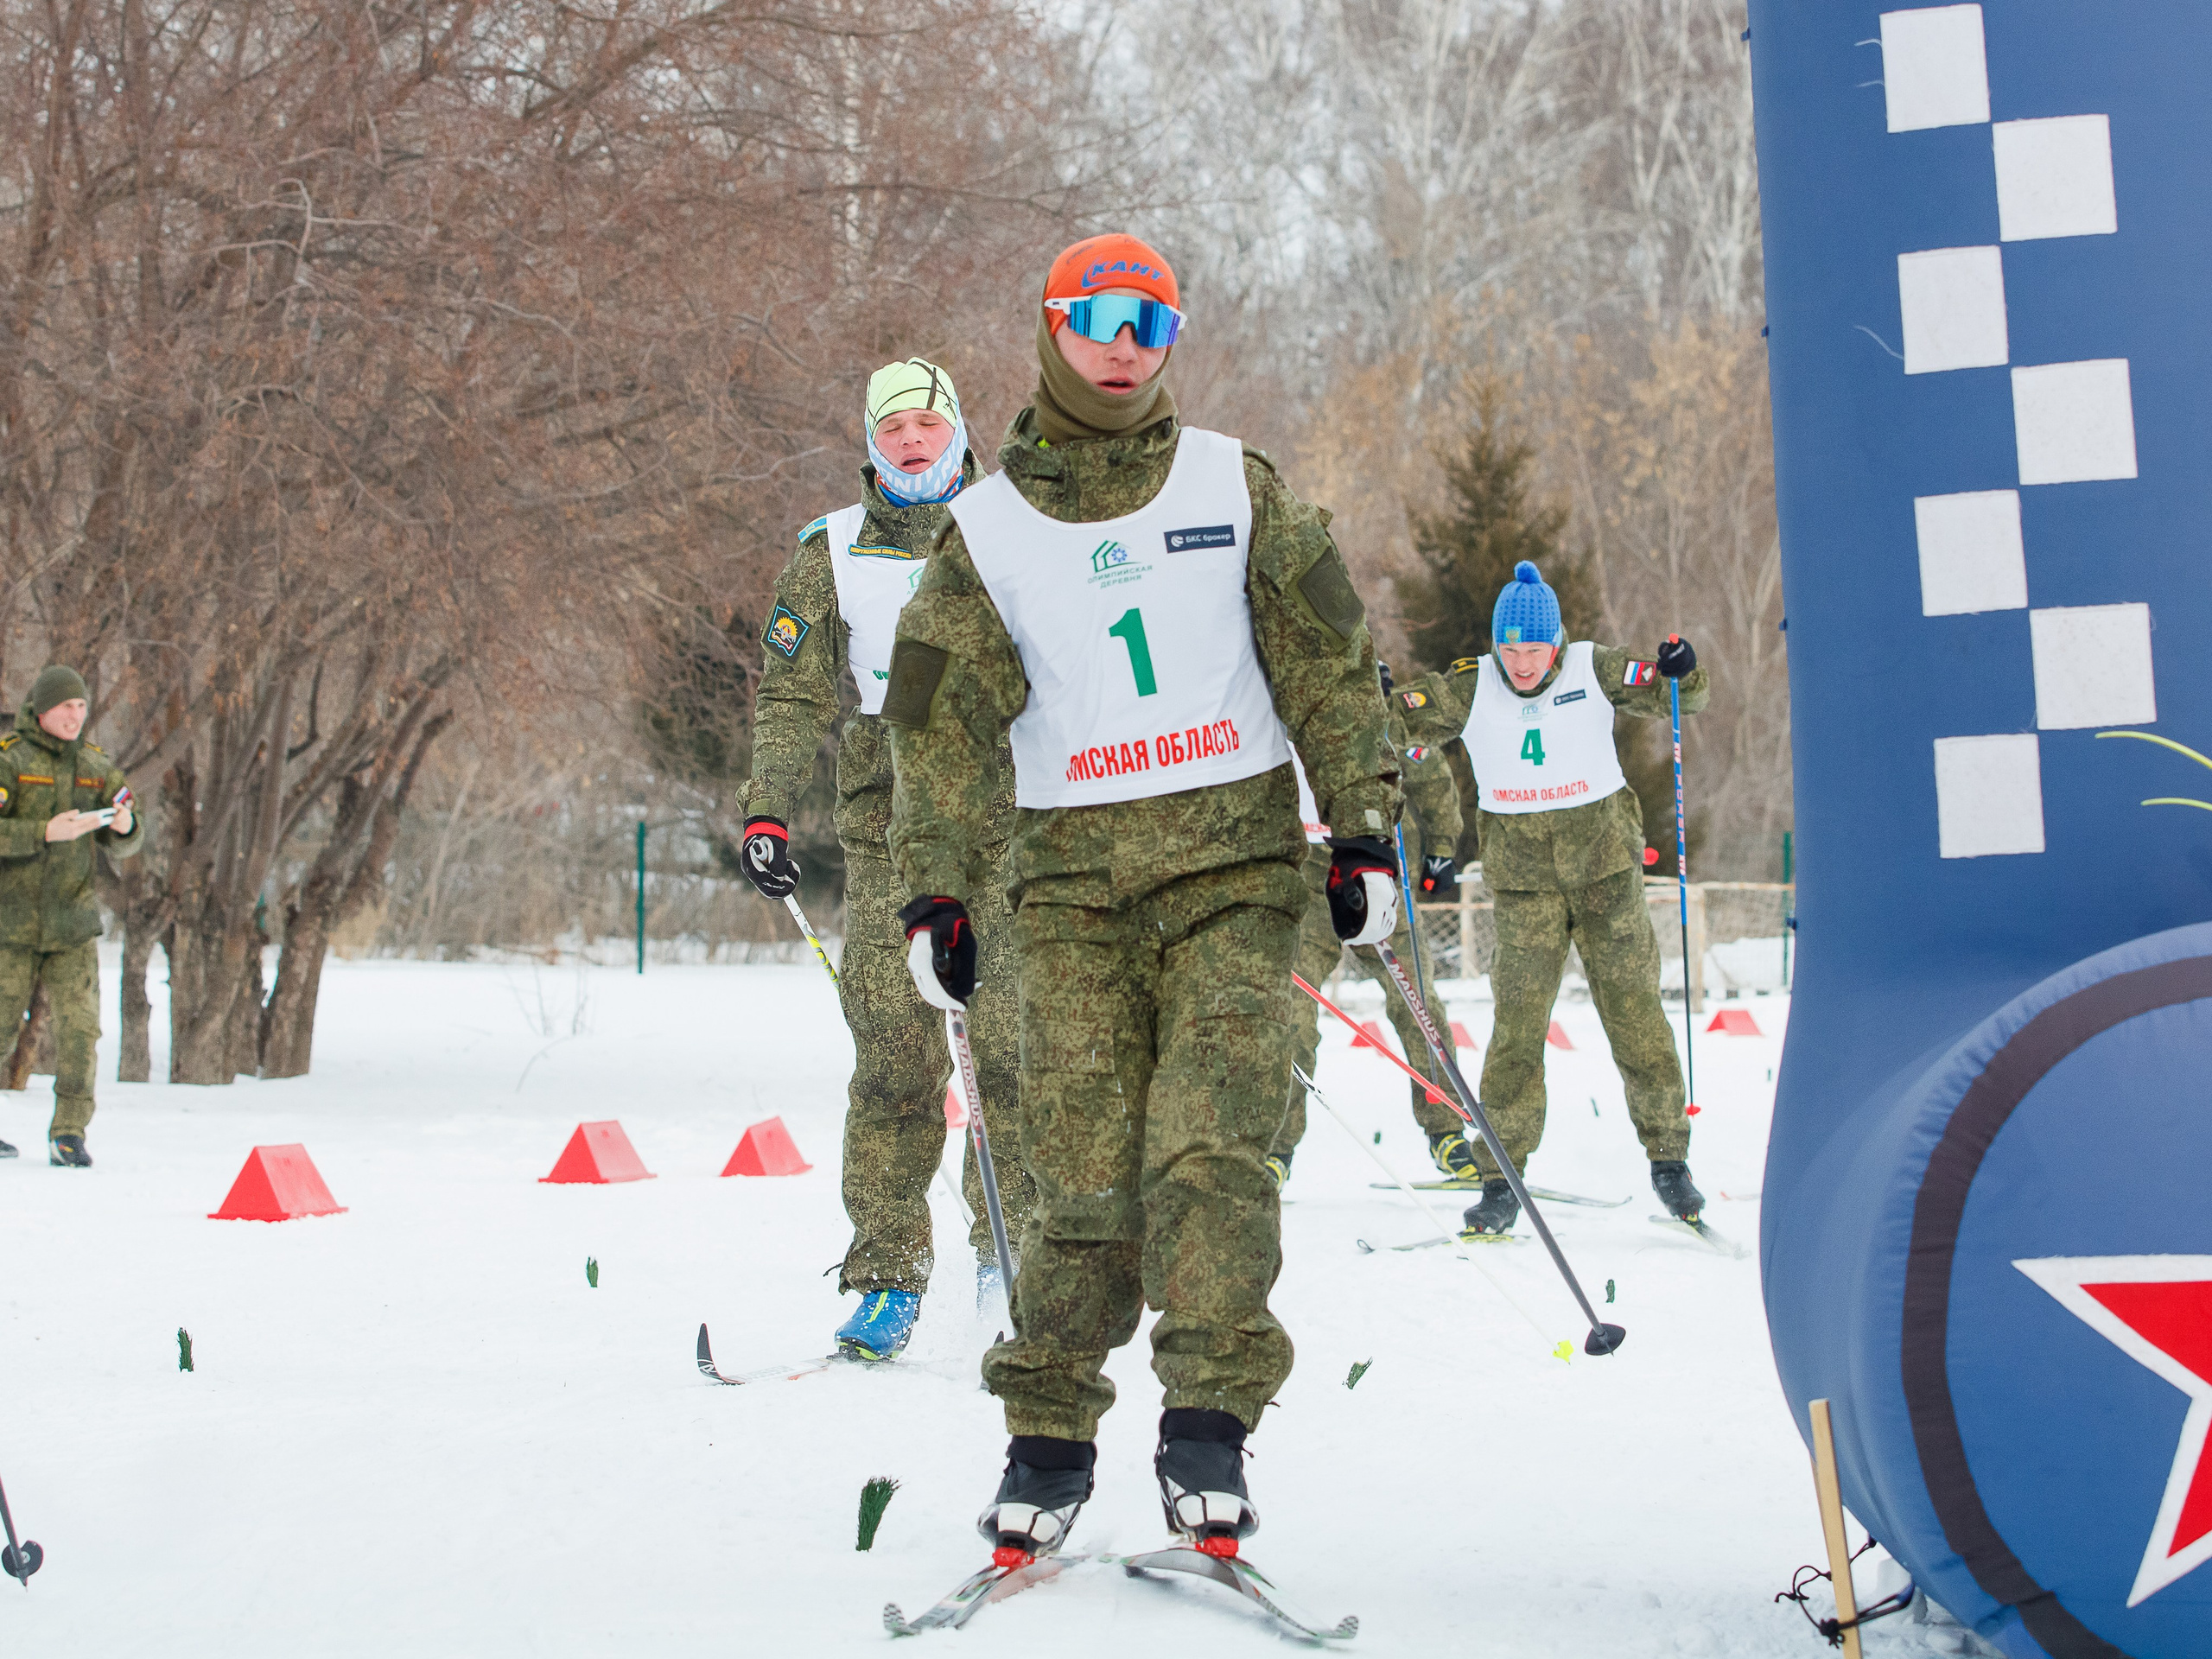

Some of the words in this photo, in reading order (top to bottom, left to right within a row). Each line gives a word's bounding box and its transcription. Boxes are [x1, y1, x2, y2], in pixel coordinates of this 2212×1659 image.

[1100, 575, 1142, 589] ДЕРЕВНЯ
[1109, 607, 1158, 697] 1
[1155, 719, 1240, 767] ОБЛАСТЬ
[1521, 728, 1546, 766] 4
[1492, 789, 1537, 802] ОМСКАЯ
[1541, 780, 1589, 801] ОБЛАСТЬ
[1389, 963, 1440, 1042] MADSHUS
[956, 1038, 982, 1126] MADSHUS
